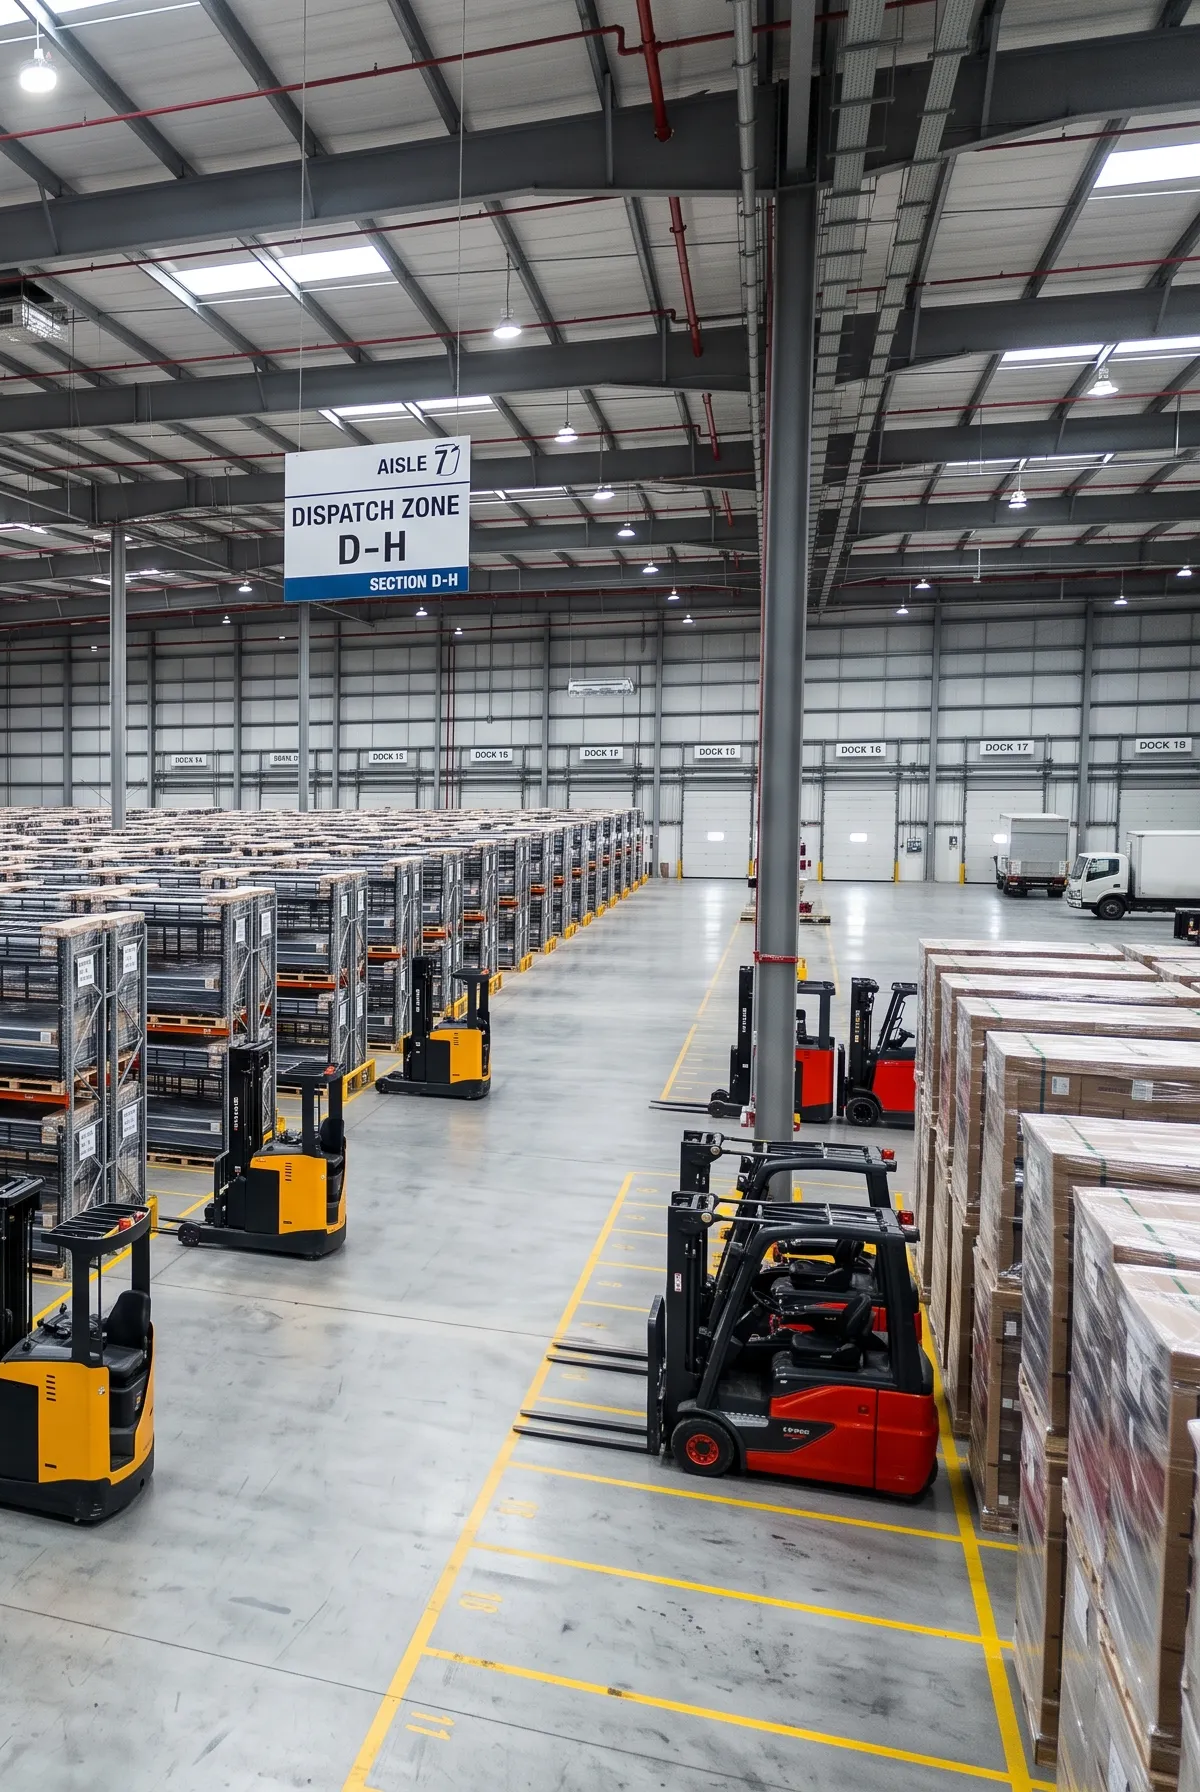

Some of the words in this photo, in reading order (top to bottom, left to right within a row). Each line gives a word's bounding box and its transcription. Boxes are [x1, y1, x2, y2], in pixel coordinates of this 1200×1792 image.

[377, 455, 427, 475] AISLE
[292, 499, 394, 527] DISPATCH
[402, 494, 460, 519] ZONE
[369, 575, 427, 591] SECTION
[432, 572, 459, 588] D-H
[841, 746, 867, 754] DOCK
[870, 745, 882, 754] 16
[985, 743, 1013, 751] DOCK
[1017, 743, 1029, 751] 17
[1140, 741, 1170, 750] DOCK
[475, 751, 496, 759] DOCK
[584, 749, 607, 757] DOCK
[699, 748, 723, 756] DOCK
